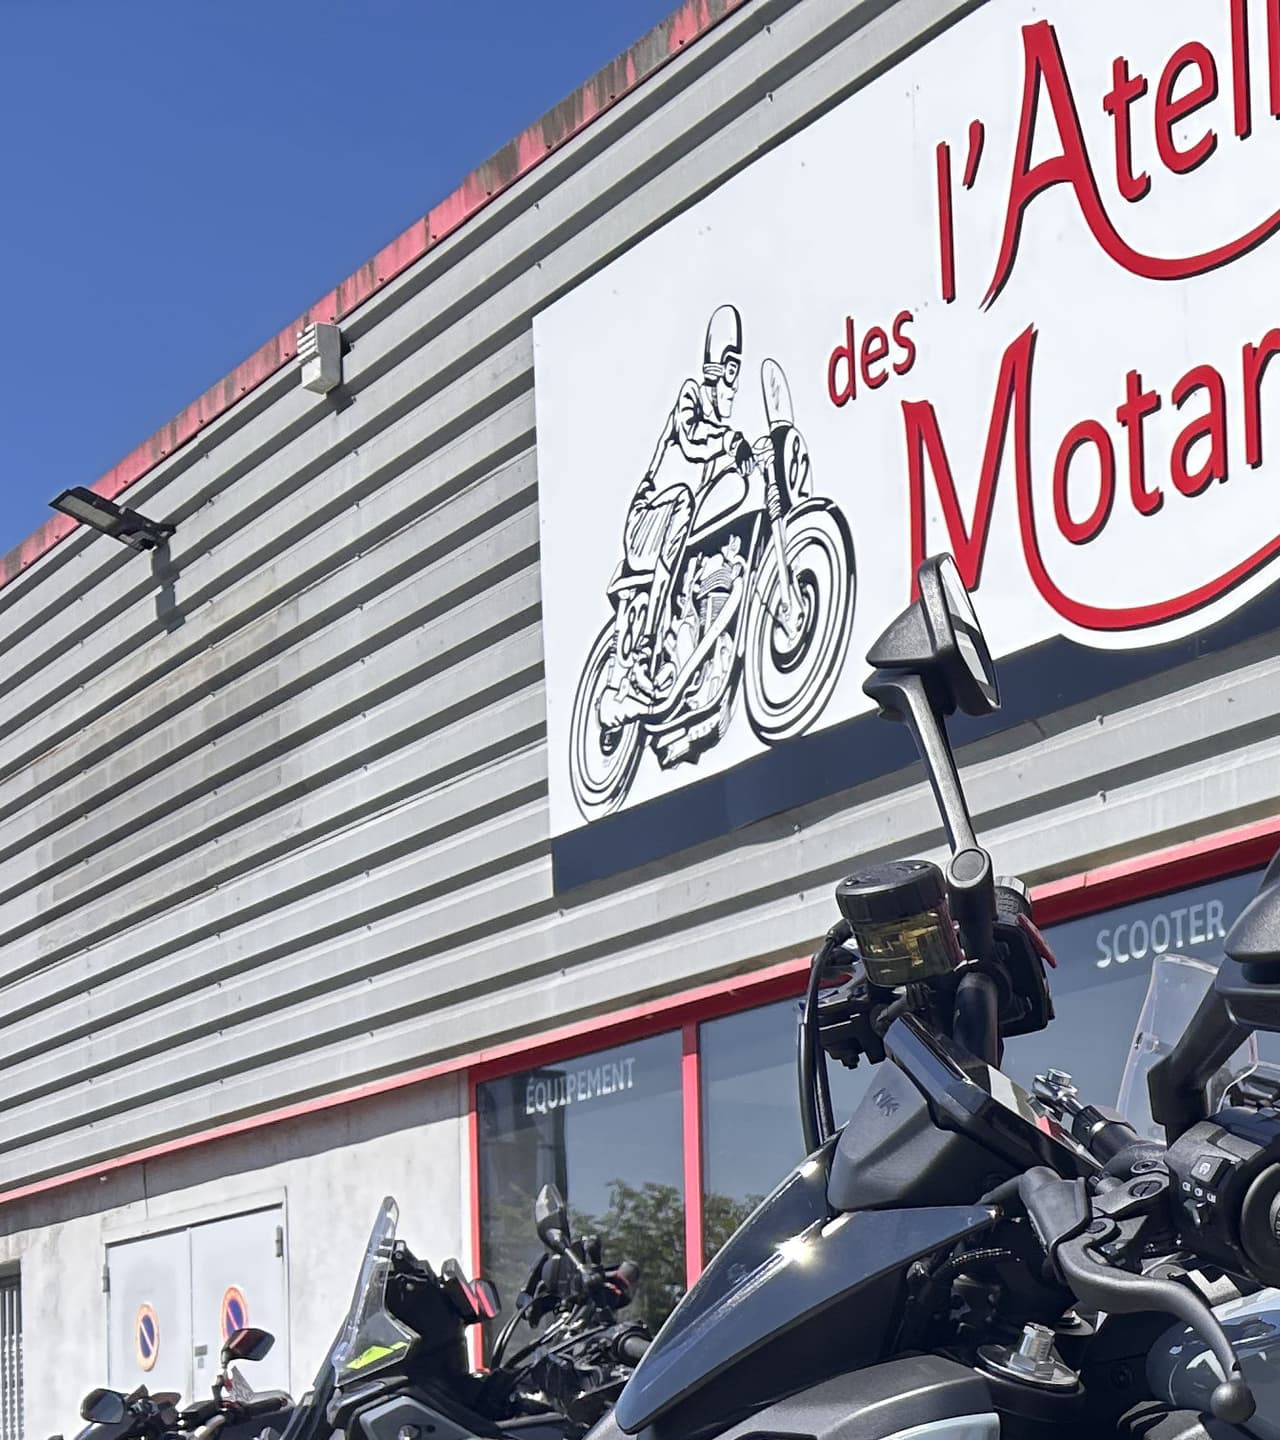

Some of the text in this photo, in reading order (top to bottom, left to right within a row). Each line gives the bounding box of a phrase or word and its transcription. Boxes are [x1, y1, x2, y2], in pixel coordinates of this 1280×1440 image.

[827, 309, 917, 408] des
[1096, 899, 1226, 968] SCOOTER
[526, 1057, 636, 1114] ÉQUIPEMENT
